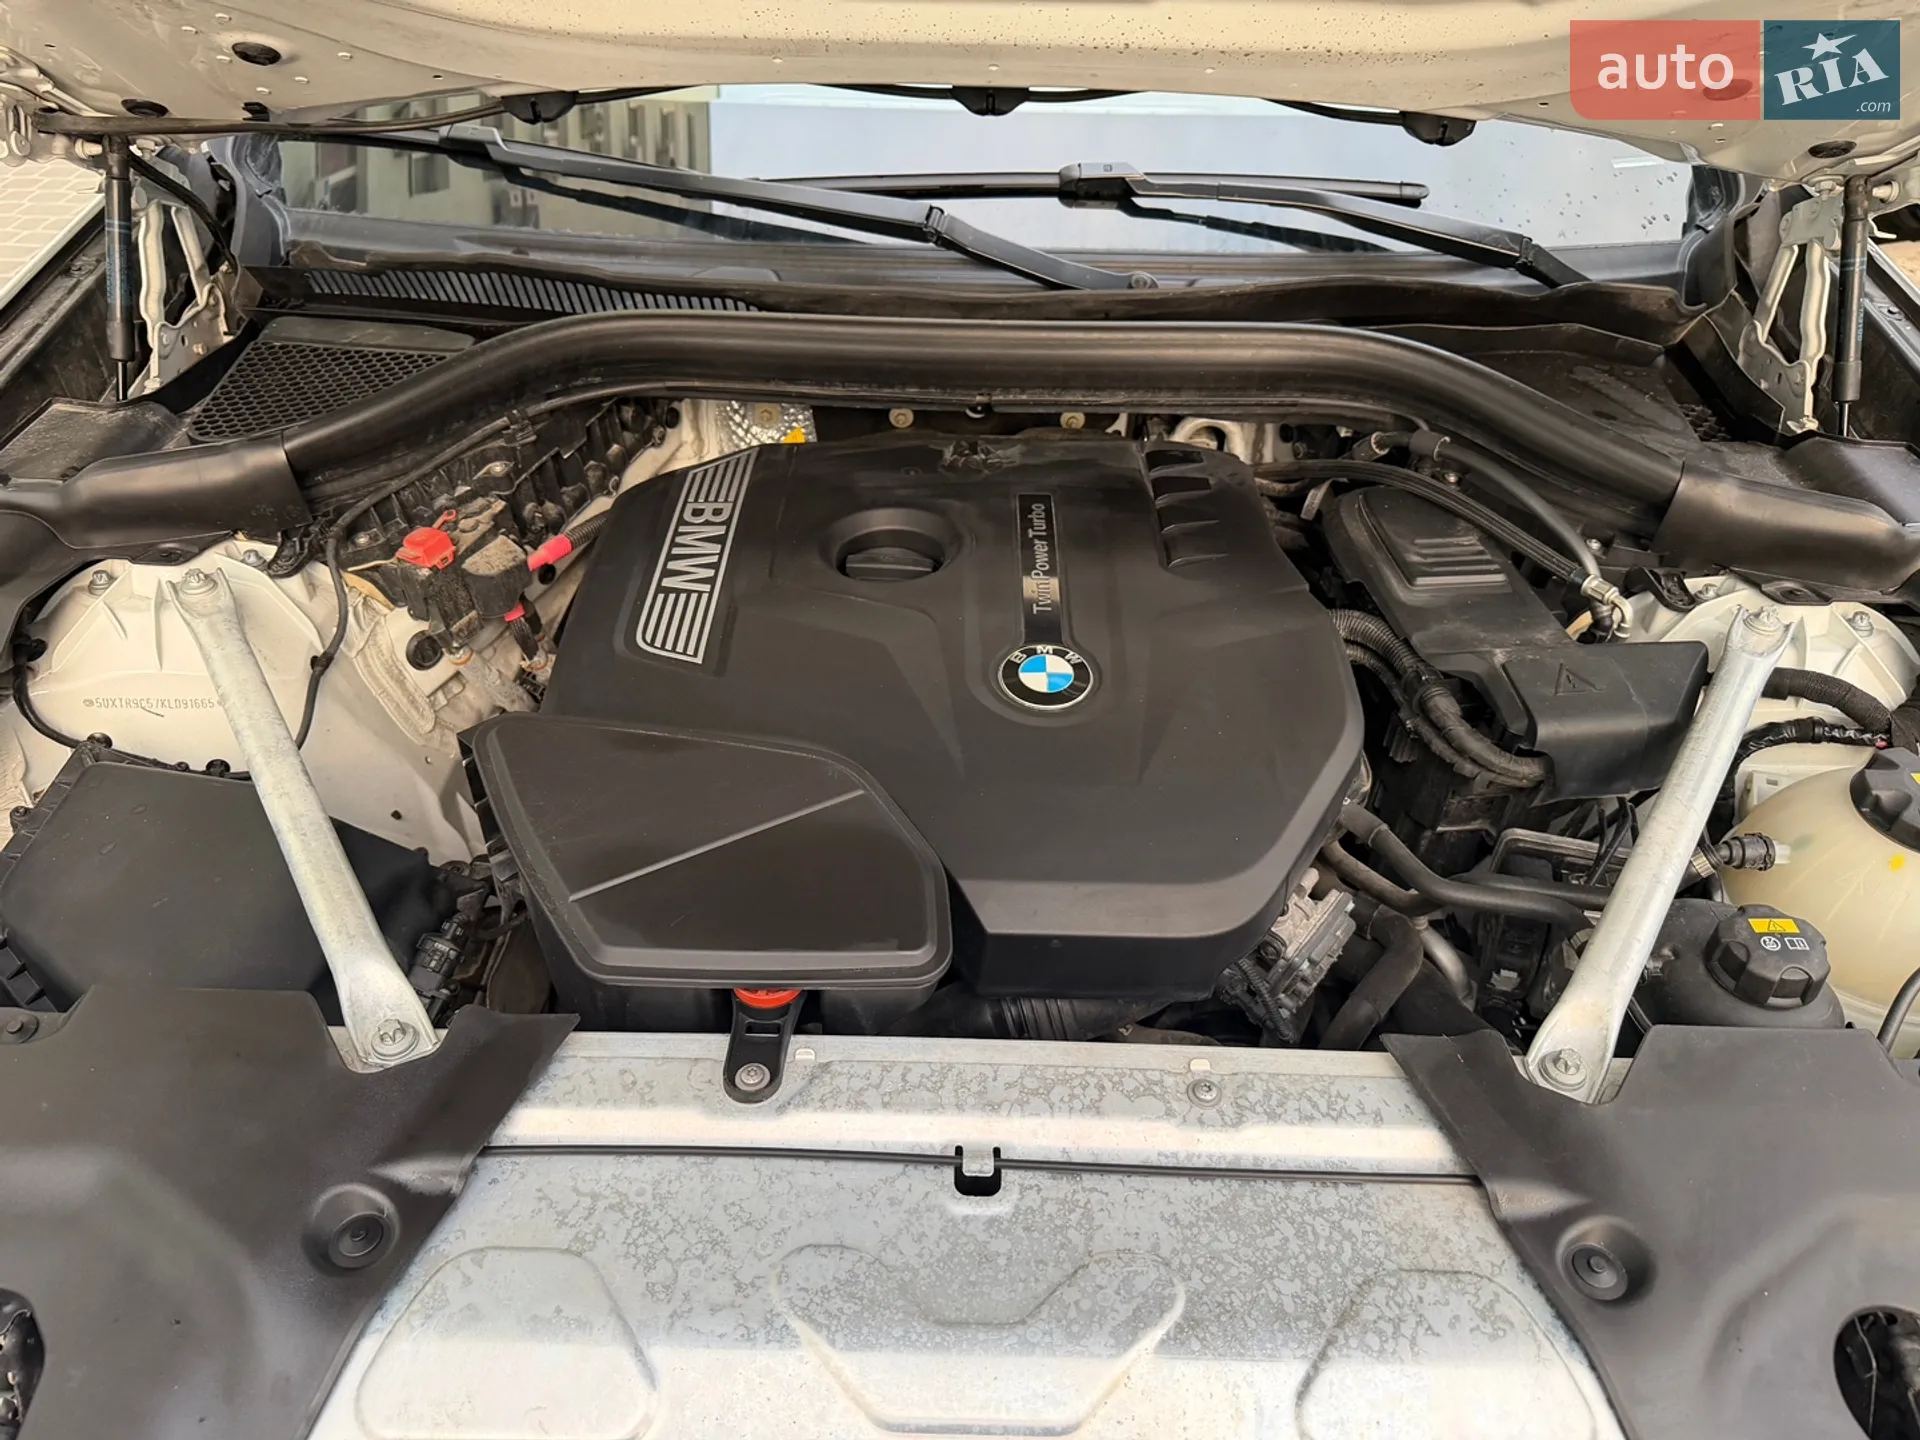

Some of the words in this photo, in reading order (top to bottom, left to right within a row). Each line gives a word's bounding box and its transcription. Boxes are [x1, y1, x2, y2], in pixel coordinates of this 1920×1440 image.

[1027, 503, 1048, 538] Turbo
[662, 502, 734, 591] BMW
[1010, 645, 1083, 664] BMW
